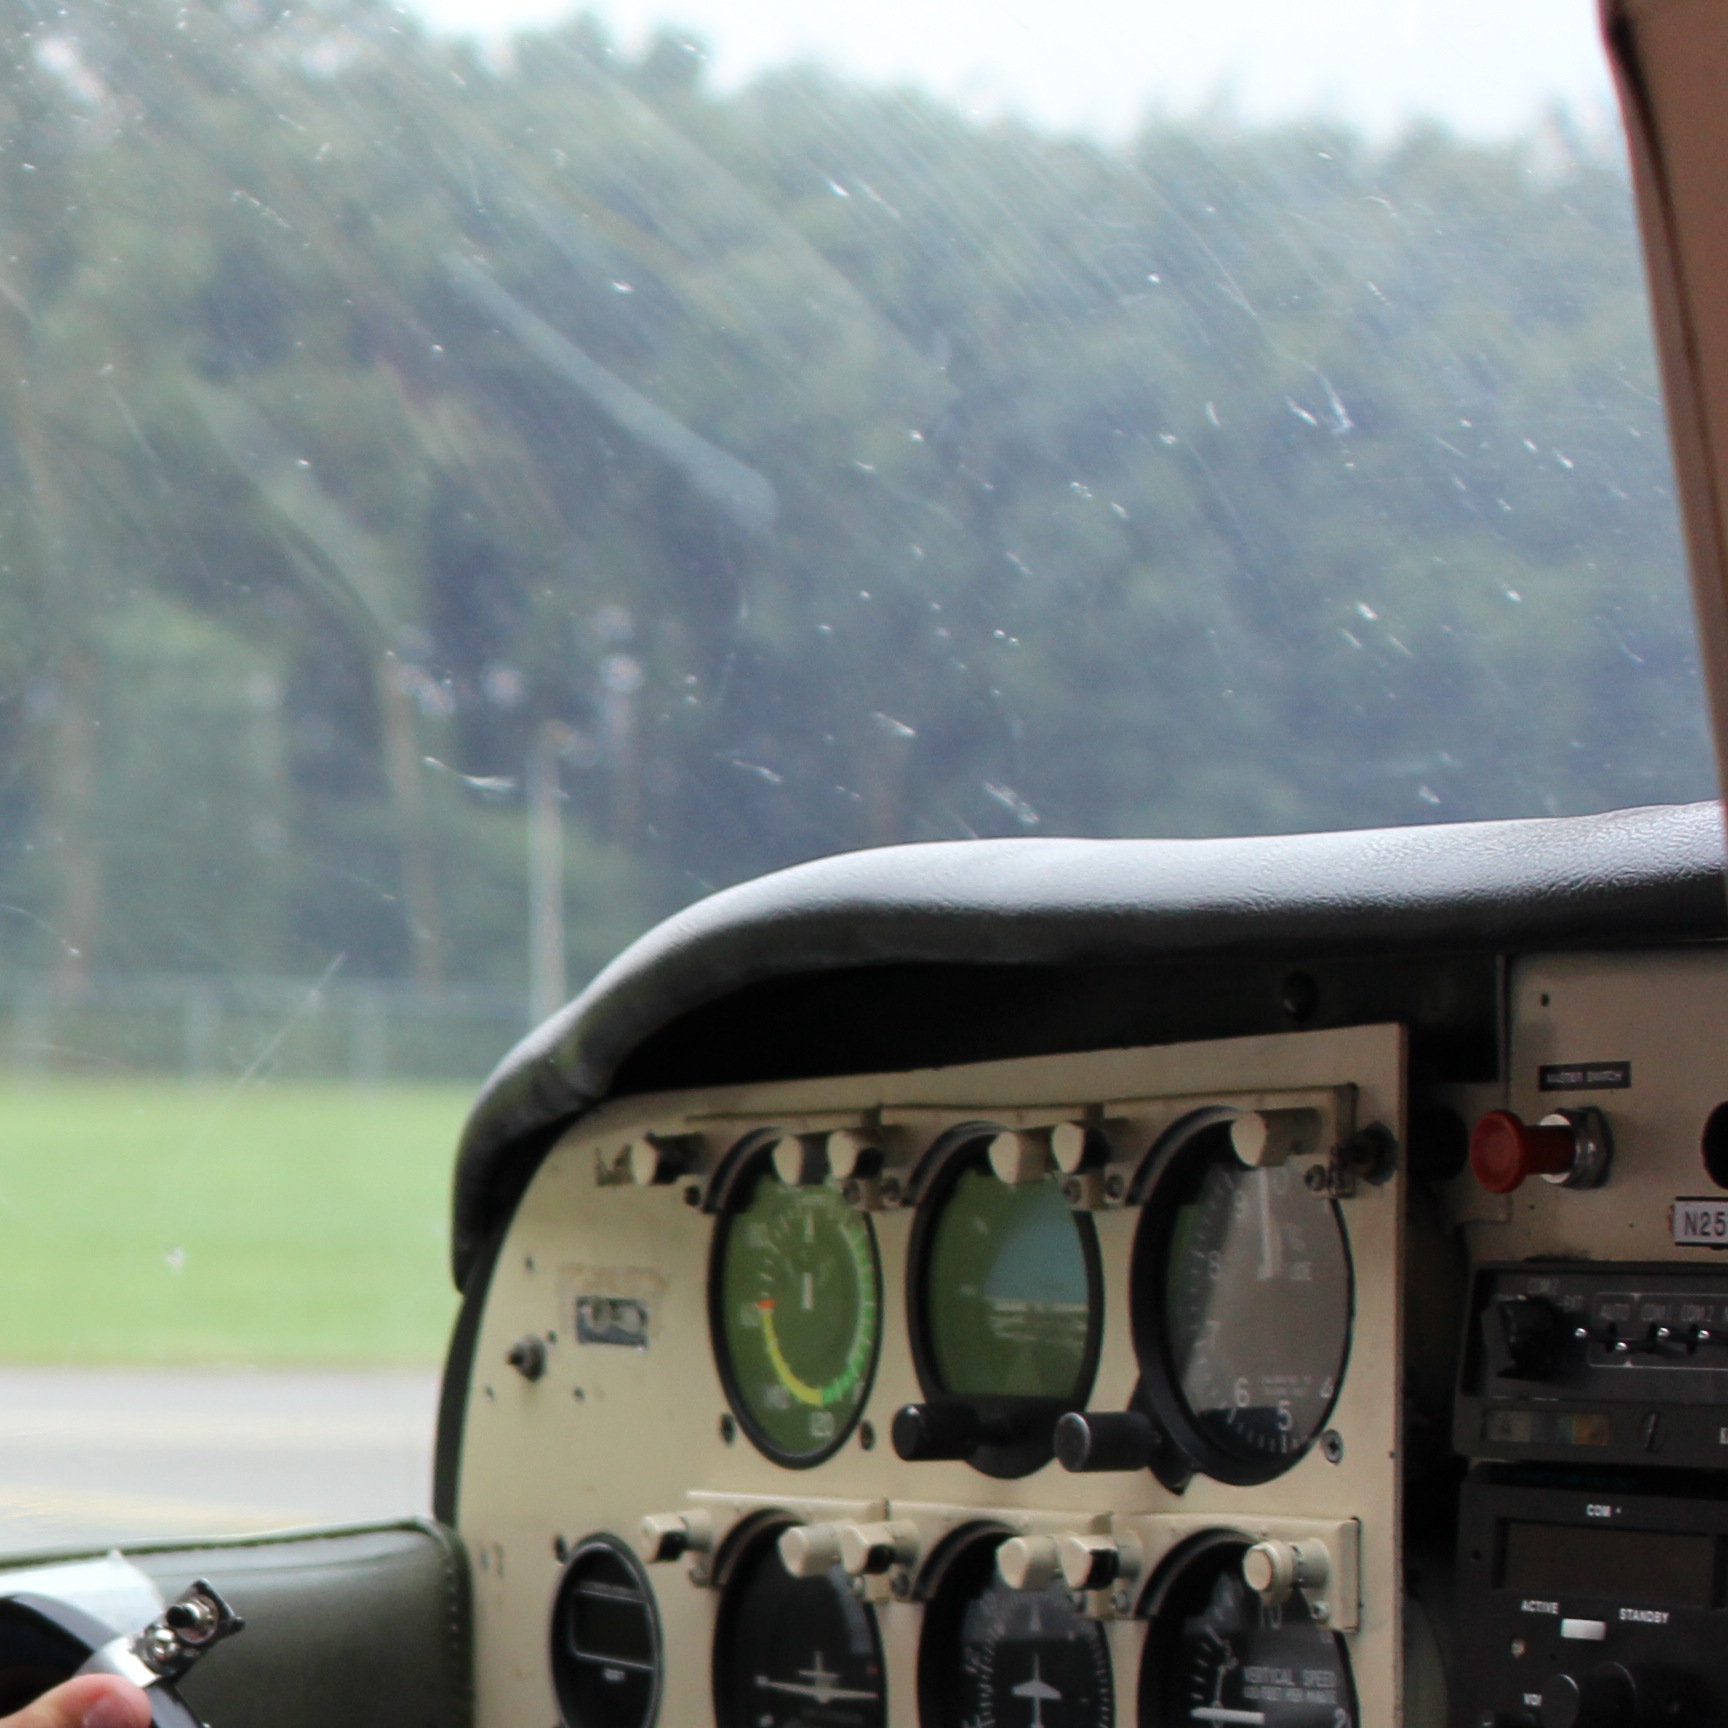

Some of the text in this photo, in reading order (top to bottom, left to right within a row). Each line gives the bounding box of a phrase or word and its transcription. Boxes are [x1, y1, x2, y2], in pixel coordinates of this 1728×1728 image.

[1233, 1376, 1250, 1408] 6
[1276, 1400, 1292, 1432] 5
[1586, 1503, 1611, 1518] COM
[1520, 1599, 1560, 1615] ACTIVE
[1619, 1608, 1670, 1624] STANDBY
[1244, 1666, 1337, 1688] VERTICAL SPEED
